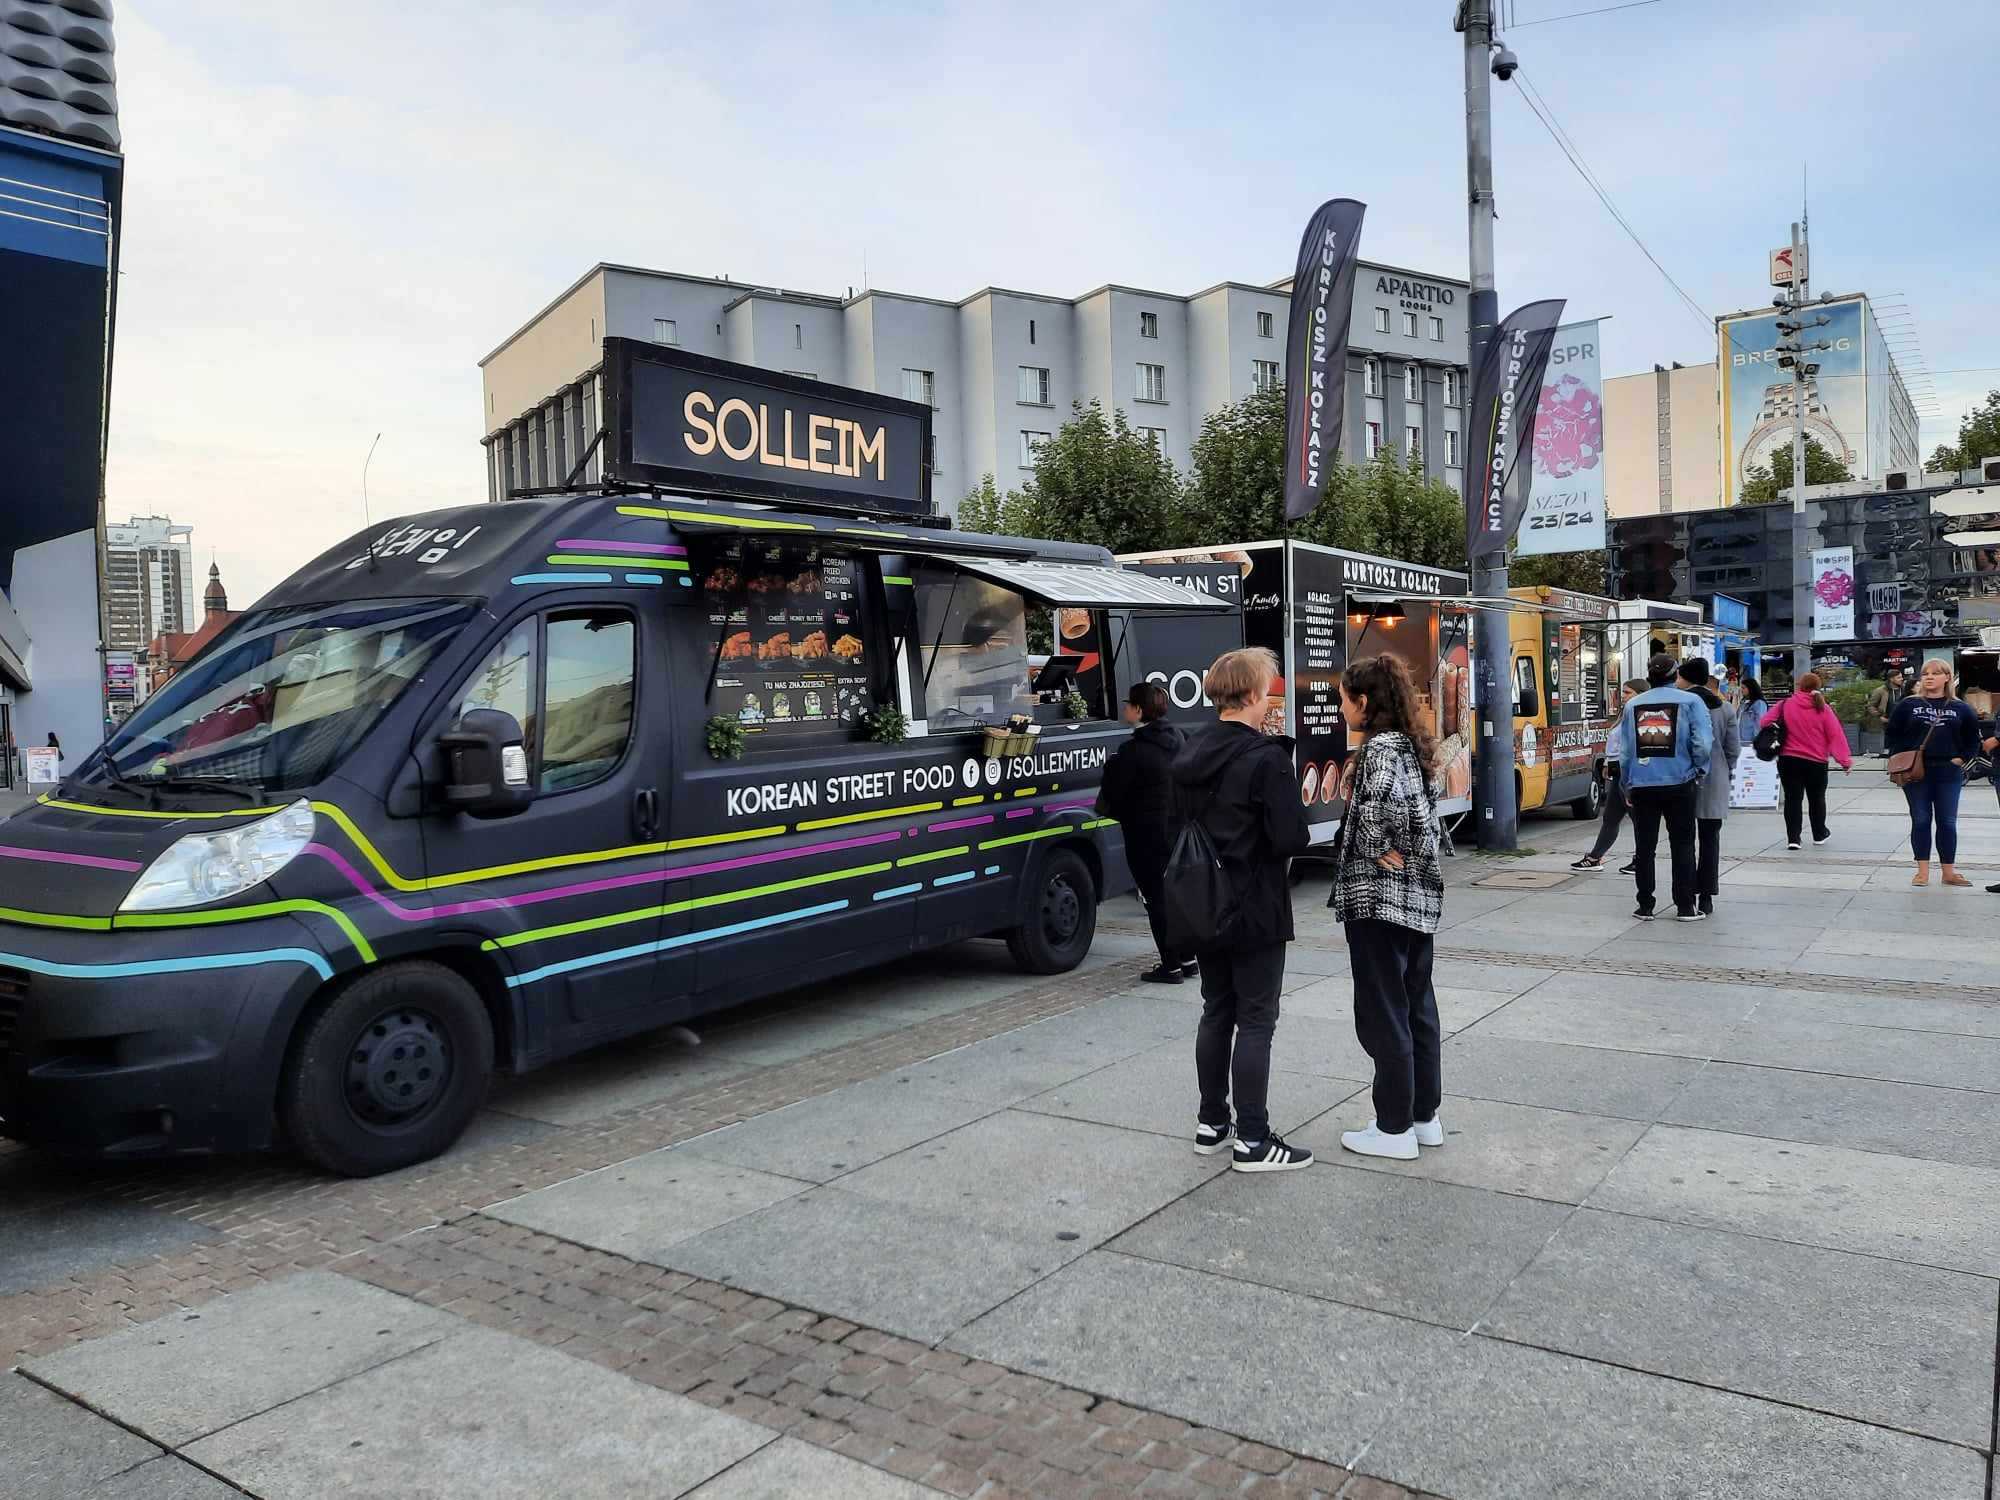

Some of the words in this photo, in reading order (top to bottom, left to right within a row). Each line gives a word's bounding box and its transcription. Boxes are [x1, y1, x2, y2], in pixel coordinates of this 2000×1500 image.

[1312, 228, 1337, 363] KURTOSZ
[1375, 275, 1455, 305] APARTIO
[1400, 299, 1433, 312] ROOMS
[1496, 328, 1528, 435] KURTOSZ
[683, 391, 885, 481] SOLLEIM
[1307, 368, 1324, 488] KOŁACZ
[1530, 511, 1593, 530] 23/24
[822, 557, 847, 567] KOREAN
[823, 567, 841, 576] FRIED
[1816, 556, 1850, 565] NOSPR
[824, 577, 851, 585] CHICKEN
[1343, 560, 1397, 588] KURTOSZ
[764, 682, 773, 690] TU
[774, 681, 788, 689] NAS
[726, 778, 817, 817] KOREAN
[825, 771, 896, 803] STREET
[903, 764, 955, 793] FOOD
[1006, 747, 1107, 780] /SOLLEIMTEAM
